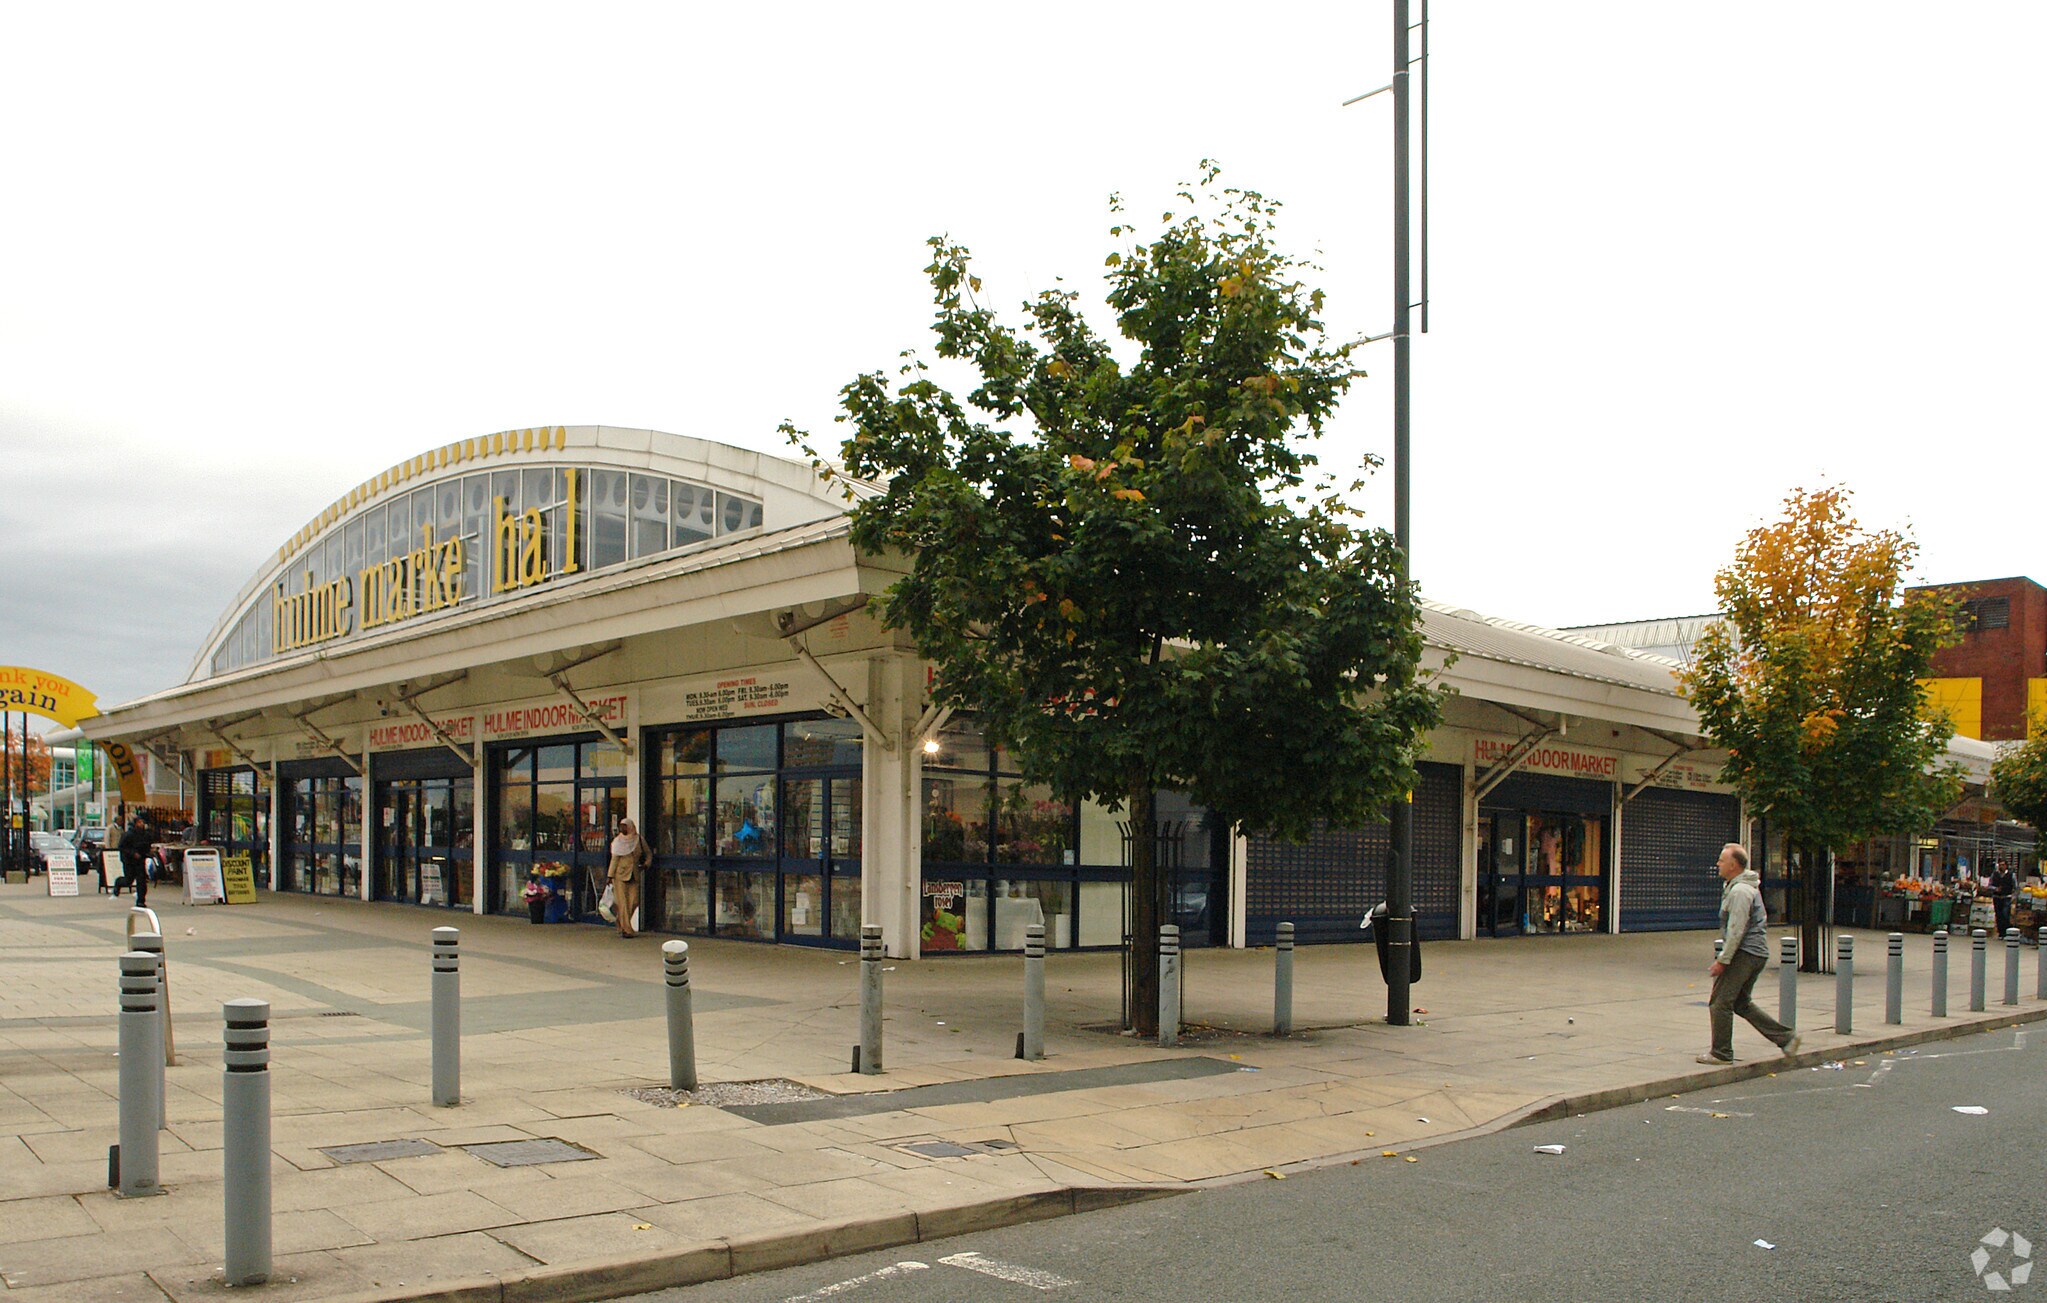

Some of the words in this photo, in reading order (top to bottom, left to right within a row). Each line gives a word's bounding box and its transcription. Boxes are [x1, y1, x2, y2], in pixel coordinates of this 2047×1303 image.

[273, 570, 352, 654] hulme
[359, 522, 463, 630] marke
[36, 675, 70, 697] you
[484, 710, 522, 733] HULME
[524, 704, 567, 729] INDOOR
[1571, 753, 1617, 775] MARKET
